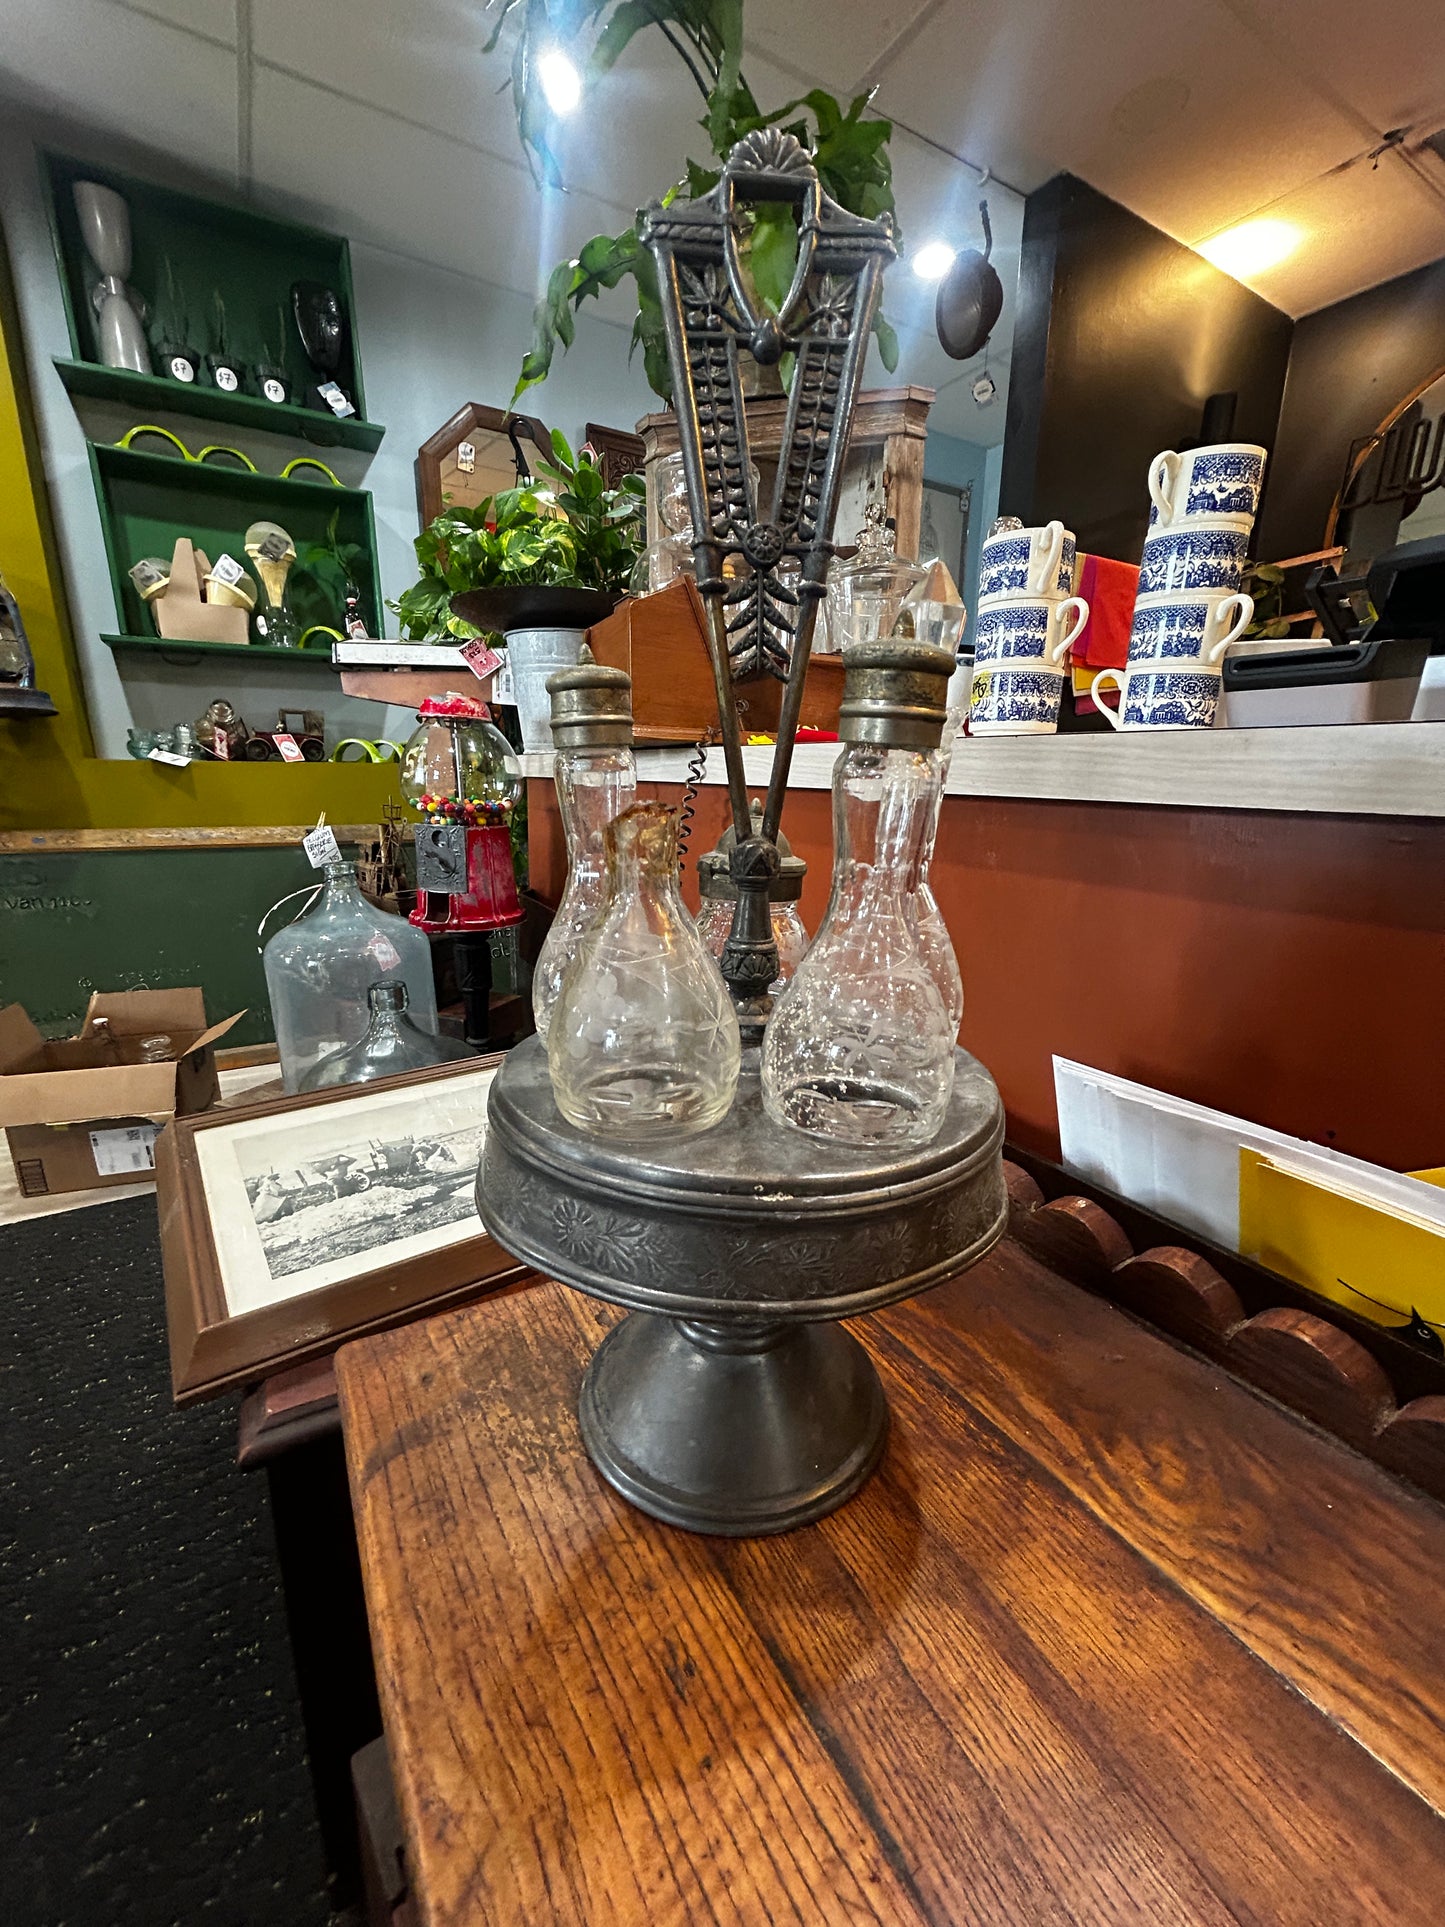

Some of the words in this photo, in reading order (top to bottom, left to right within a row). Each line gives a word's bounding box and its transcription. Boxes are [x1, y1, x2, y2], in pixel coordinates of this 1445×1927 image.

[174, 362, 187, 374] $7
[219, 372, 232, 384] $7
[267, 384, 279, 395] $7
